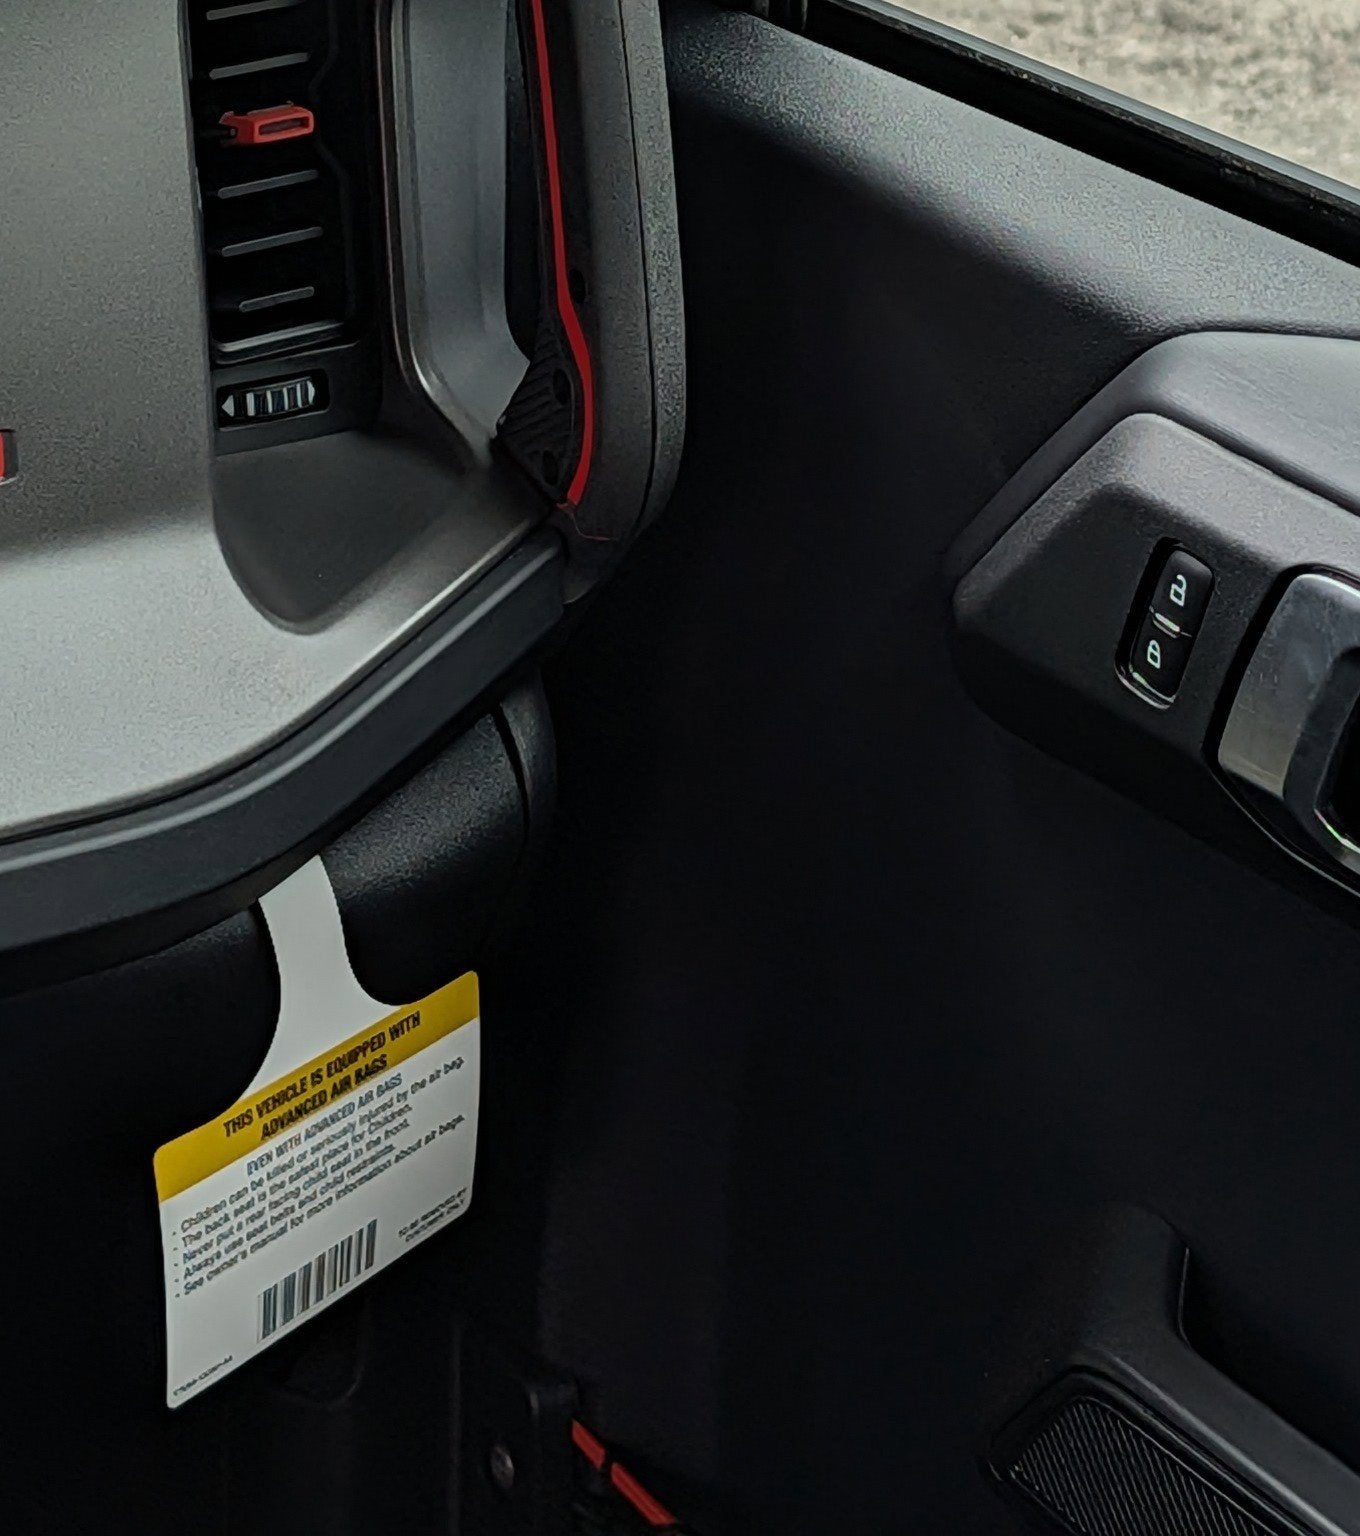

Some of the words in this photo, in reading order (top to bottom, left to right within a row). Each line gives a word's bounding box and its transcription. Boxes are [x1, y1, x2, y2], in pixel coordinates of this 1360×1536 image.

[224, 1106, 253, 1139] THIS
[256, 1075, 307, 1120] VEHICLE
[310, 1066, 322, 1088] IS
[326, 1030, 385, 1080] EQUIPPED
[388, 1009, 420, 1042] WITH
[261, 1087, 327, 1141] ADVANCED
[330, 1072, 351, 1099] AIR
[246, 1148, 272, 1177] EVEN
